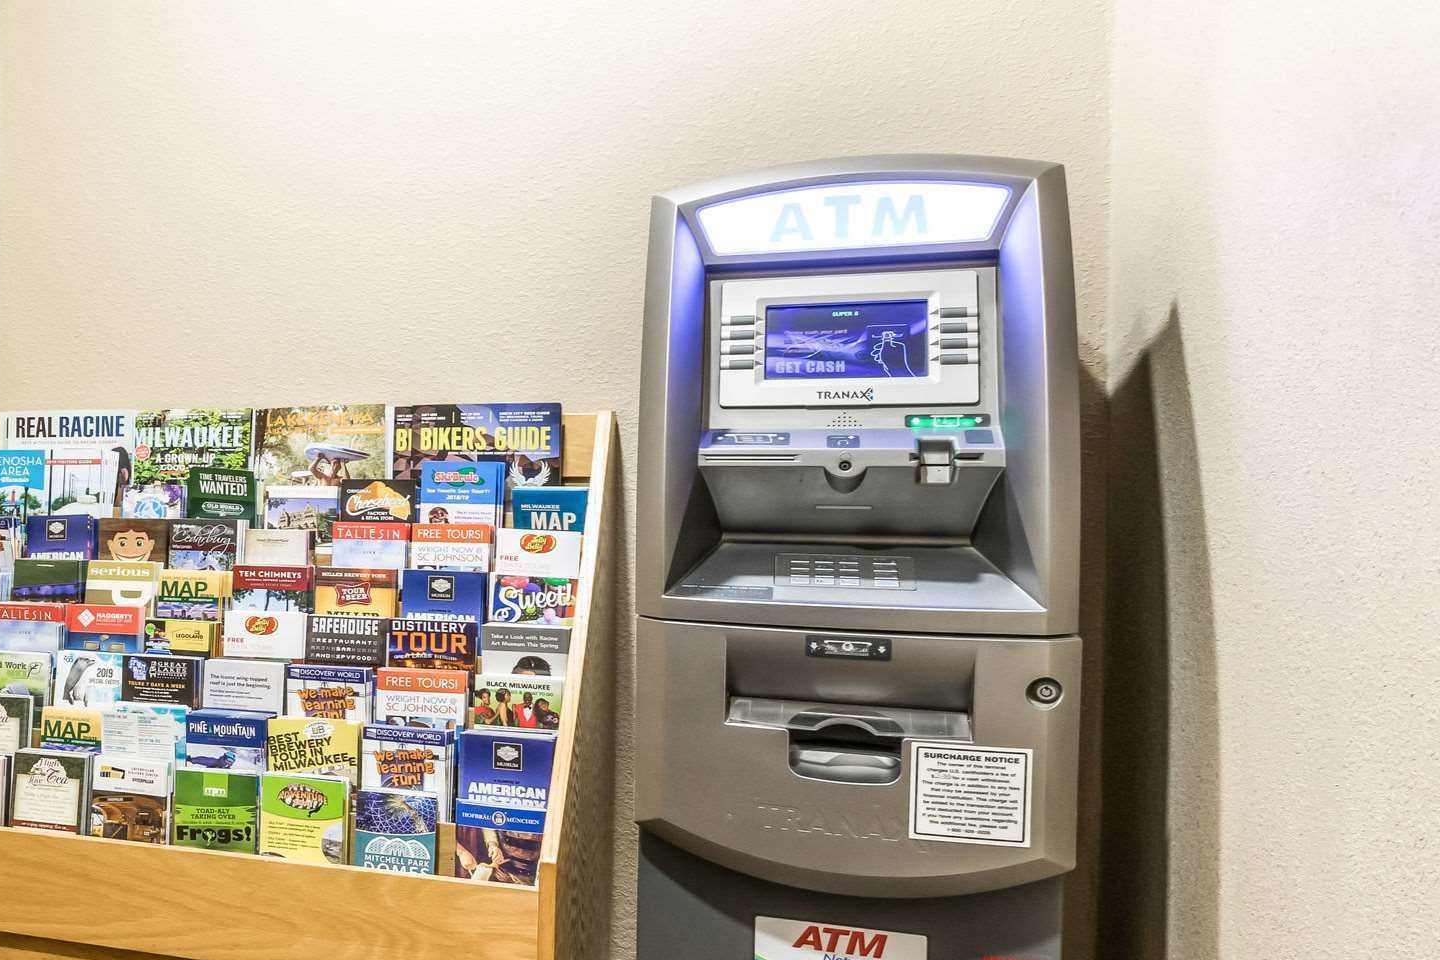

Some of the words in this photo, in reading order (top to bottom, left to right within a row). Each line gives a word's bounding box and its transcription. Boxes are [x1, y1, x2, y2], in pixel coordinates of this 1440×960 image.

[769, 194, 928, 242] ATM
[775, 362, 802, 373] GET
[805, 361, 845, 373] CASH
[15, 416, 56, 438] REAL
[59, 415, 125, 437] RACINE
[420, 427, 486, 451] BIKERS
[495, 426, 551, 450] GUIDE
[0, 466, 30, 476] AREA
[200, 481, 247, 496] WANTED!
[531, 513, 576, 530] MAP
[336, 527, 401, 540] TALIESIN
[90, 566, 151, 577] serious
[239, 570, 258, 578] TEN
[260, 571, 302, 580] CHIMNEYS
[312, 617, 378, 635] SAFEHOUSE
[392, 621, 467, 633] DISTILLERY
[392, 632, 467, 654] TOUR
[386, 676, 411, 687] FREE
[417, 678, 458, 689] TOURS!
[509, 682, 550, 690] MILWAUKEE
[386, 702, 399, 711] SC
[403, 703, 457, 714] JOHNSON
[43, 720, 91, 739] MAP
[189, 721, 208, 733] PINE
[214, 721, 256, 739] MOUNTAIN
[268, 732, 299, 744] BEST
[269, 736, 332, 754] BREWERY
[272, 752, 307, 762] TOUR
[310, 749, 323, 758] IN
[923, 752, 981, 761] SURCHARGE
[985, 756, 1020, 764] NOTICE
[392, 774, 421, 786] fun!
[176, 825, 251, 845] Frogs!
[365, 854, 404, 865] MITCHELL
[408, 860, 429, 868] PARK
[792, 925, 888, 959] ATM
